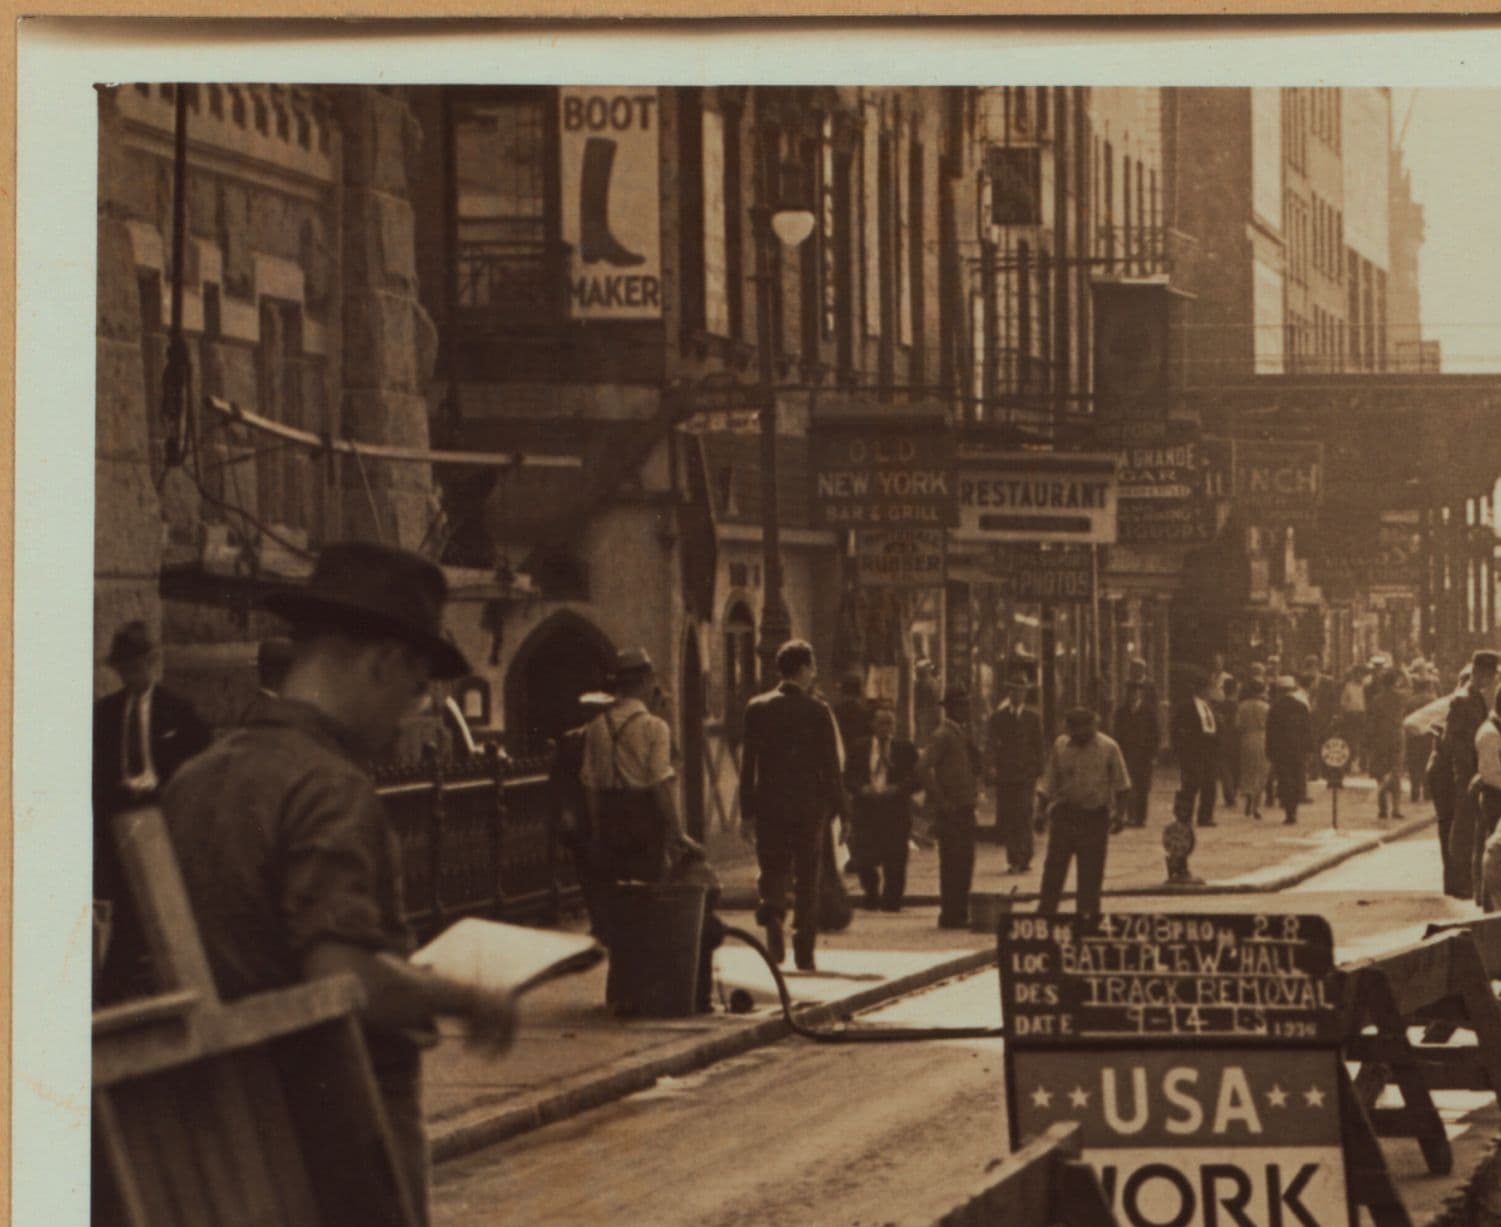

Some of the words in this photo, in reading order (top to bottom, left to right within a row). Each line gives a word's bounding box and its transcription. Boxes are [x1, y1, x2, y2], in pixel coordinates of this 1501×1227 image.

[563, 95, 657, 131] BOOT
[572, 275, 660, 308] MAKER
[848, 439, 916, 463] OLD
[816, 470, 870, 497] NEW
[877, 469, 949, 496] YORK
[1118, 470, 1178, 482] GAR
[960, 479, 1109, 508] RESTAURANT
[825, 504, 864, 521] BAR
[887, 504, 940, 521] GRILL
[1009, 918, 1048, 940] JOB
[1012, 952, 1048, 973] LOC
[1015, 983, 1059, 1005] DES
[1083, 976, 1186, 1006] TRACK
[1195, 978, 1334, 1010] REMOVAL
[1015, 1014, 1073, 1036] DATE
[1101, 1066, 1263, 1135] USA
